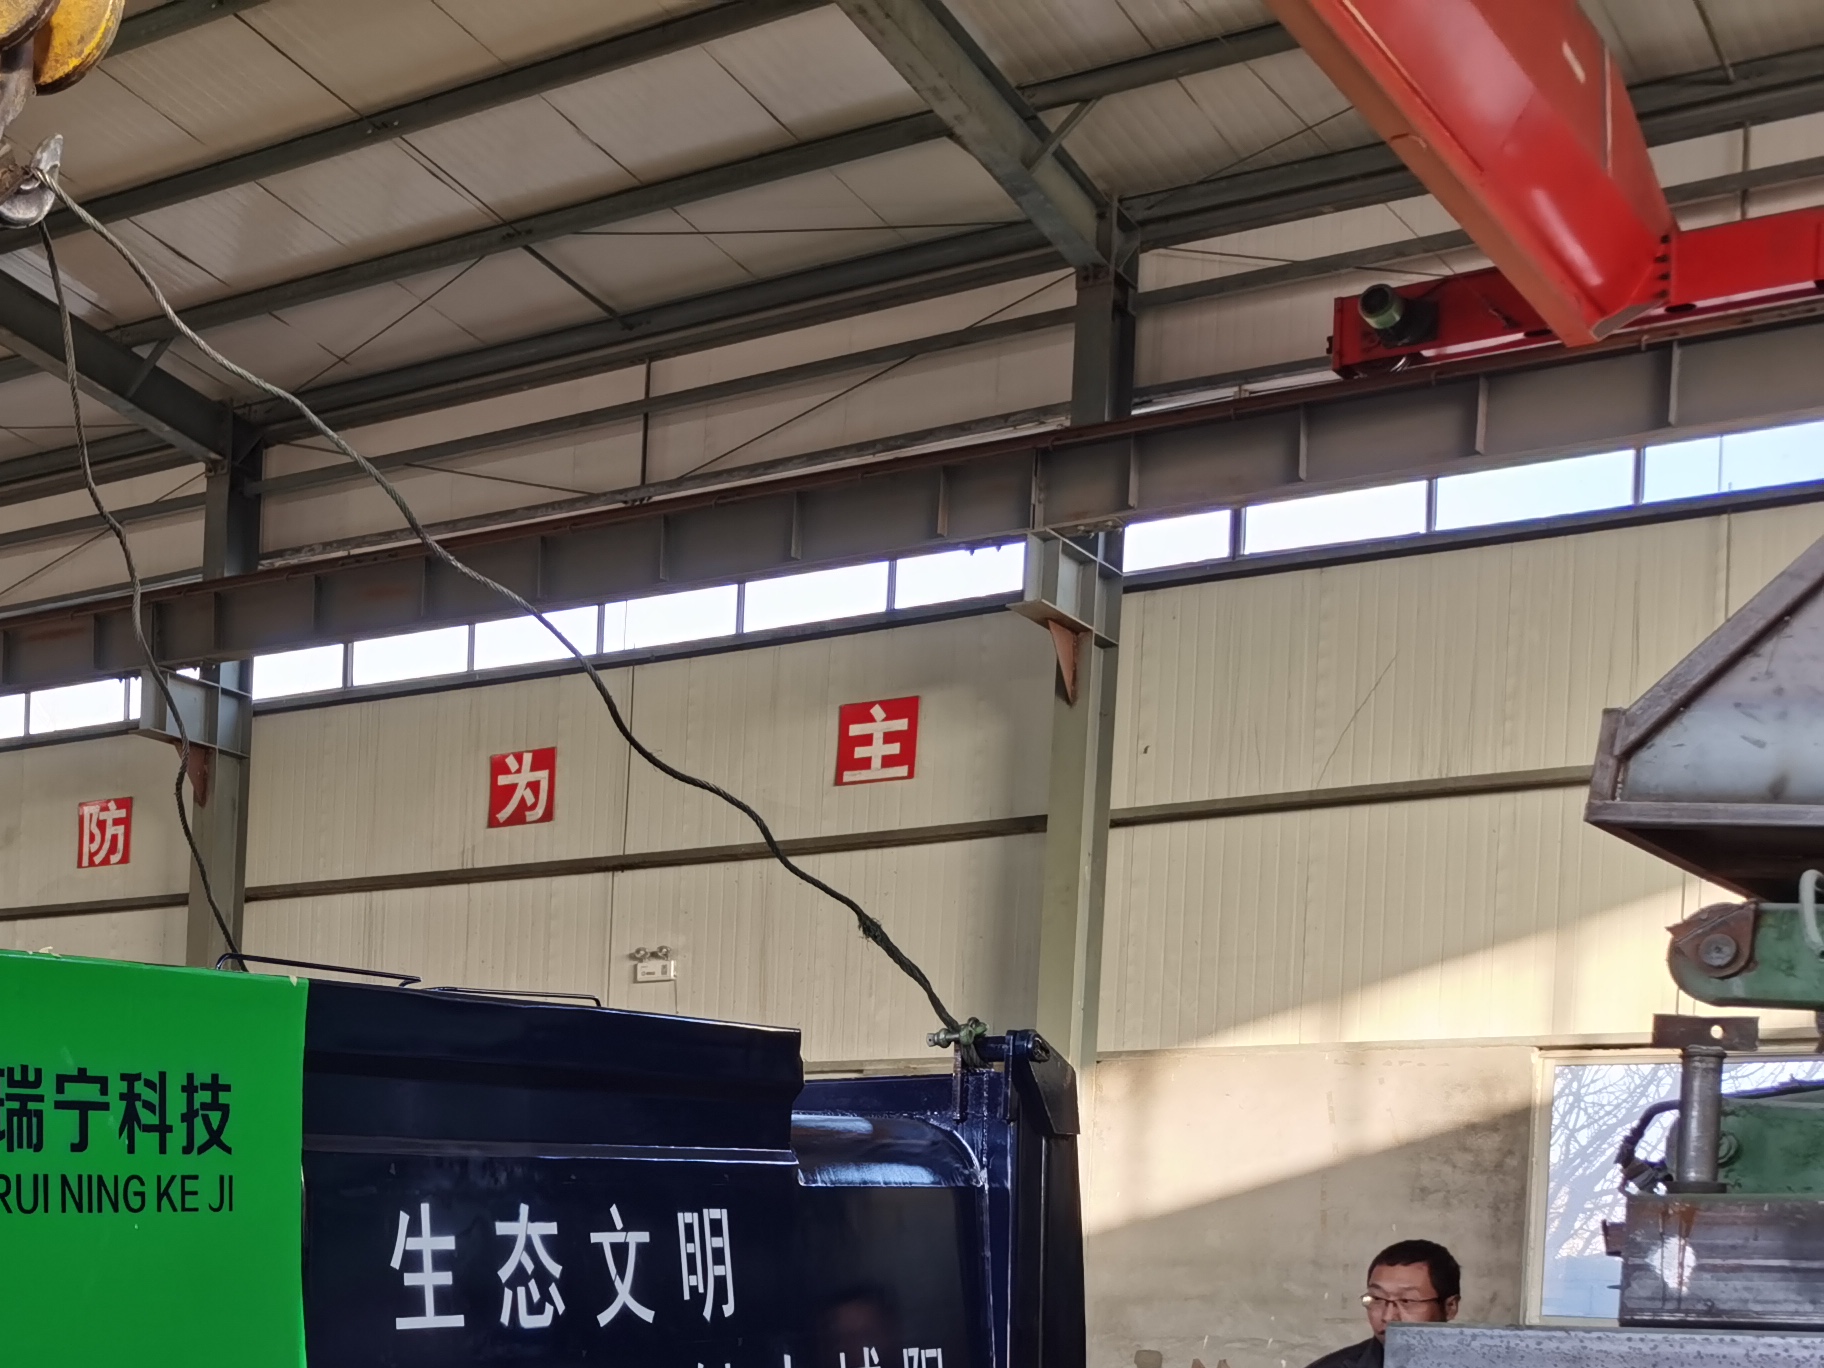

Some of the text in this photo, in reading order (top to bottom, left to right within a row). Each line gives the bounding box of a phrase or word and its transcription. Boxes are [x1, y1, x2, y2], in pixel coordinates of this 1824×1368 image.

[81, 799, 127, 867] 防
[495, 752, 551, 824] 为
[841, 703, 909, 784] 主
[60, 1173, 146, 1214] NING
[155, 1174, 200, 1213] KE
[208, 1174, 234, 1213] JI
[389, 1201, 736, 1331] 生态文明
